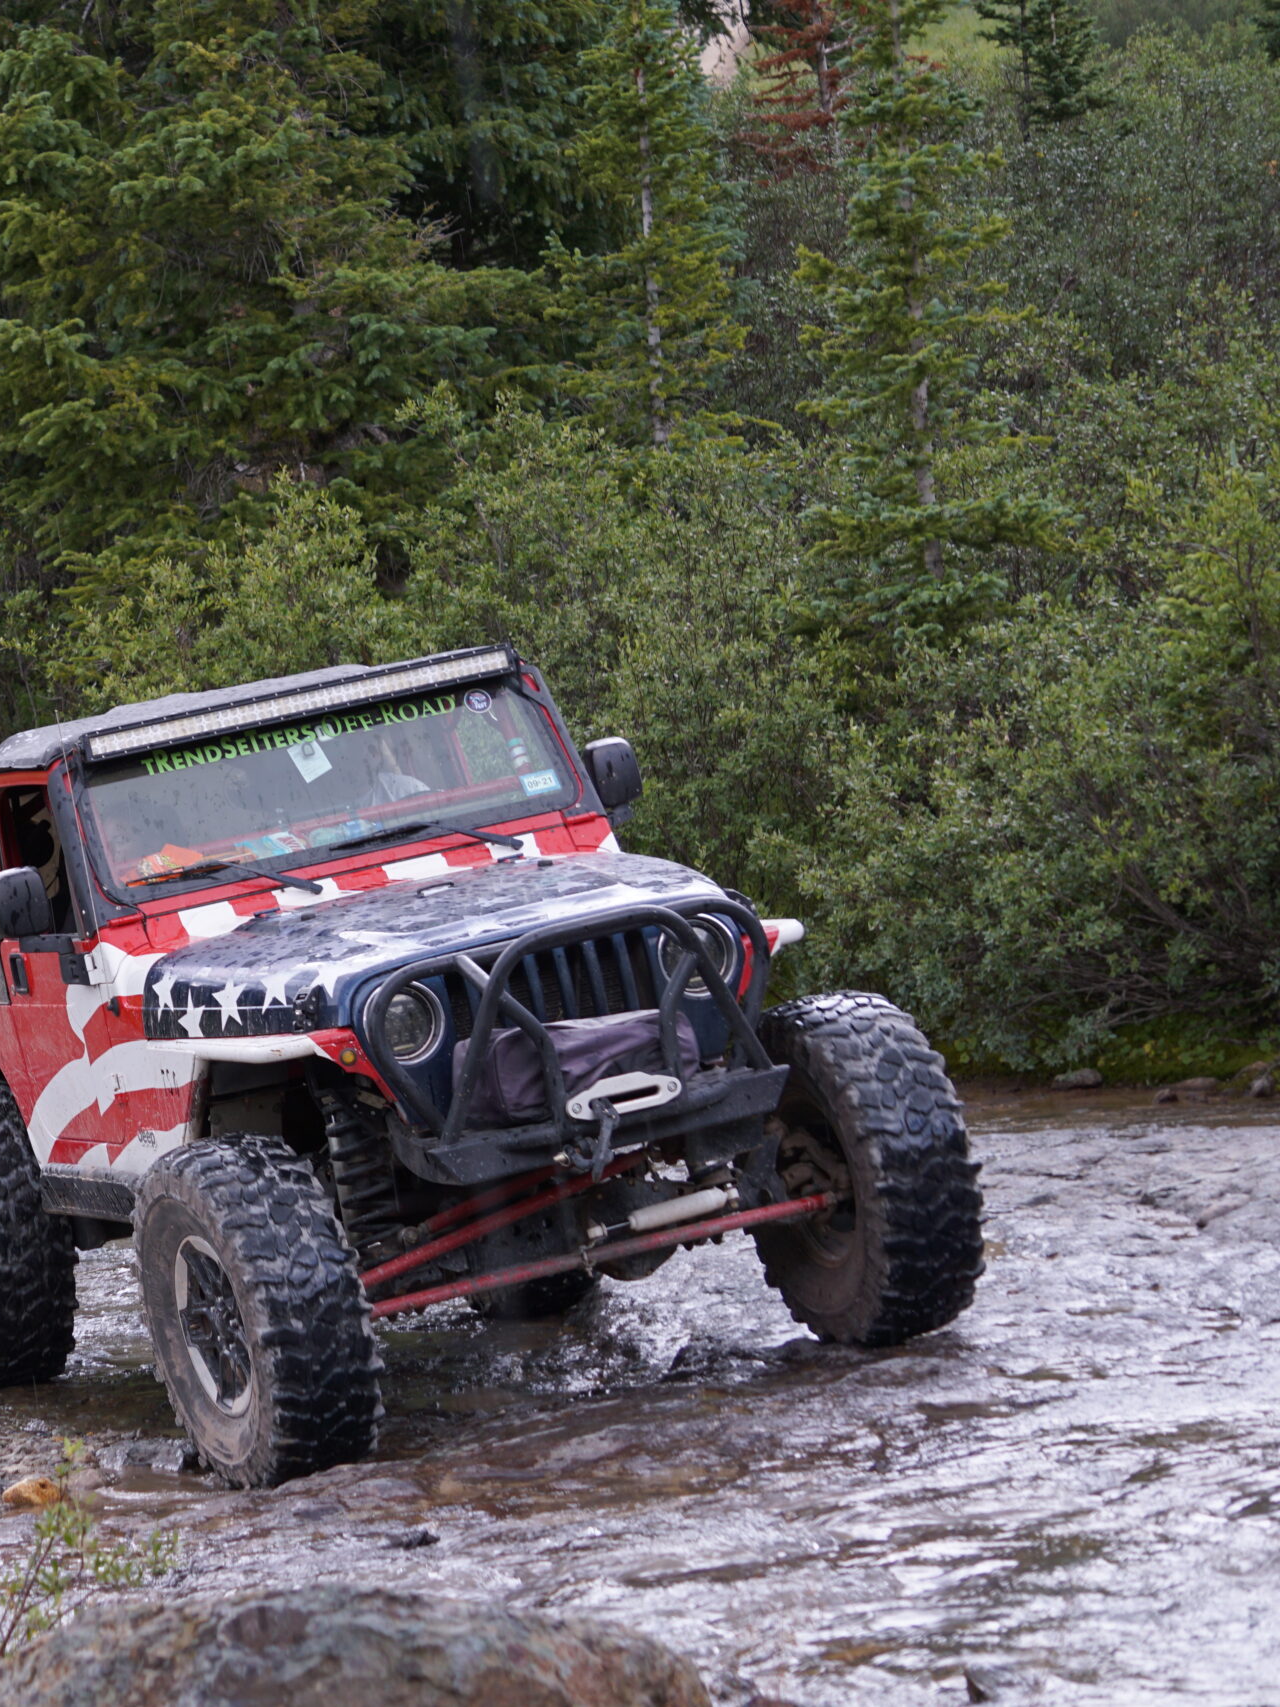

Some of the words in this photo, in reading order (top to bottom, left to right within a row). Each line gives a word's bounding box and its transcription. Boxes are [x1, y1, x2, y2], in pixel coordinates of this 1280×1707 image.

[141, 724, 317, 776] TRENDSETTERS
[320, 696, 456, 737] OFF-ROAD
[138, 1129, 155, 1148] Jeep
